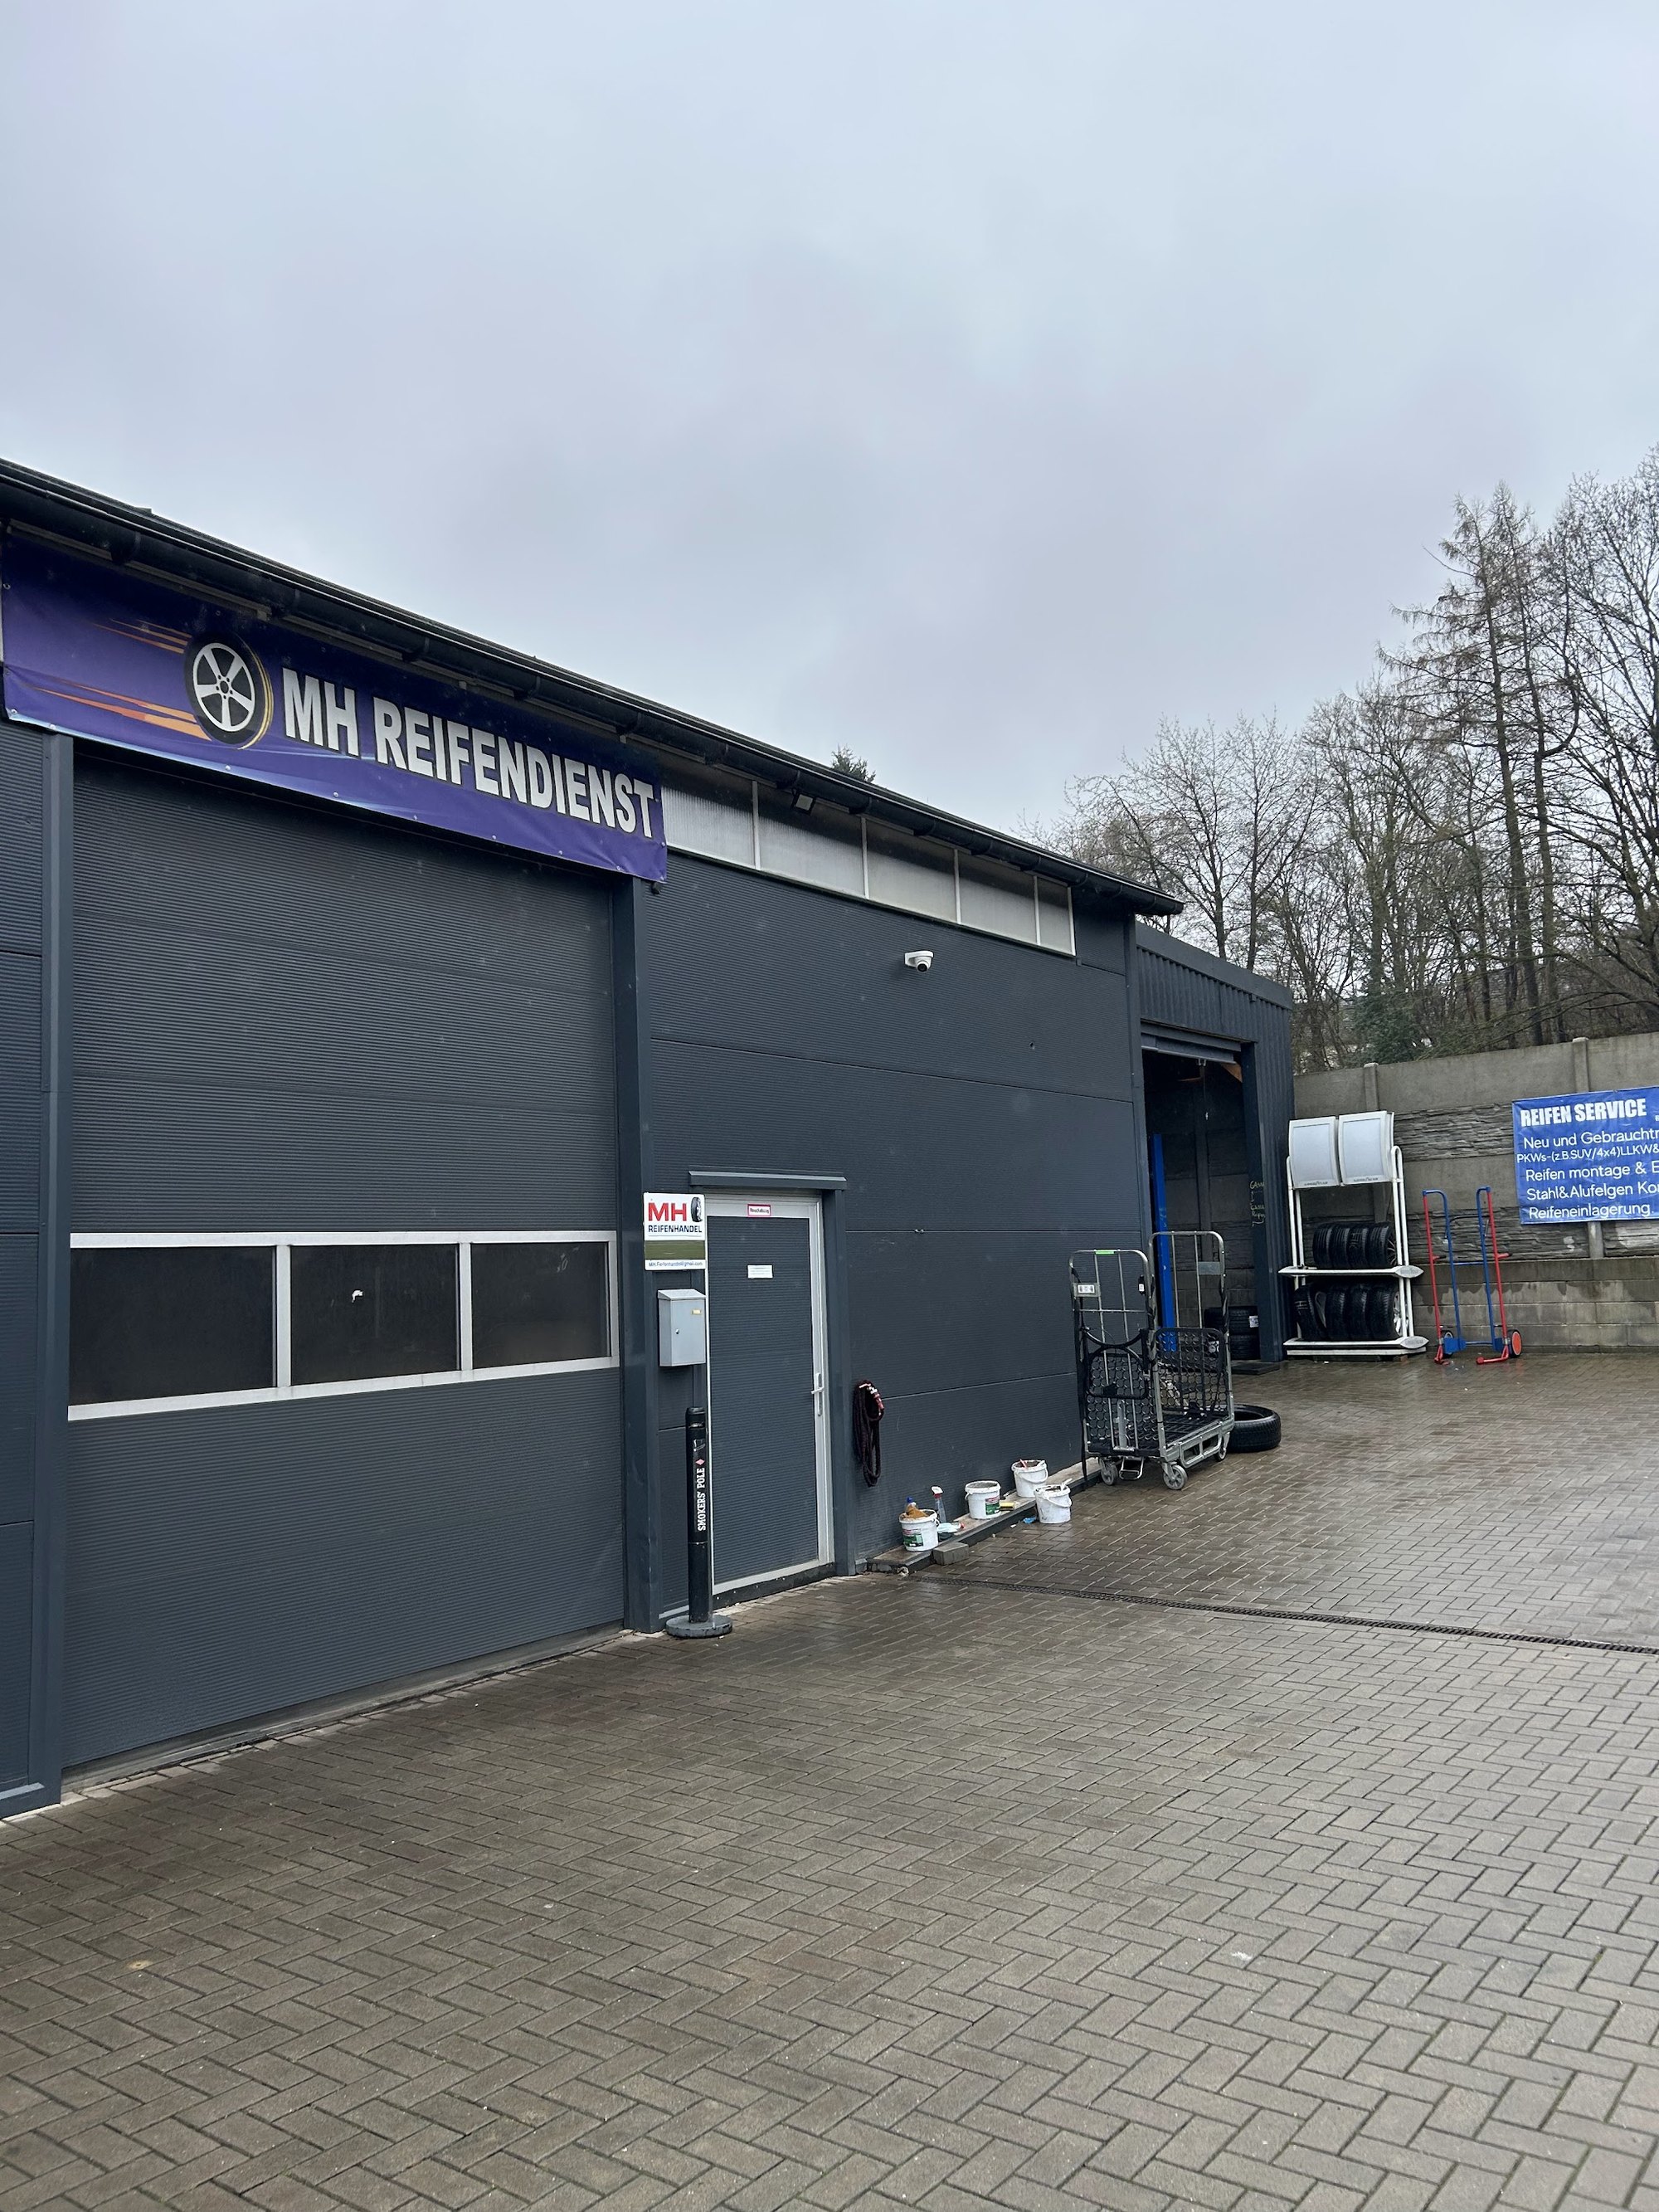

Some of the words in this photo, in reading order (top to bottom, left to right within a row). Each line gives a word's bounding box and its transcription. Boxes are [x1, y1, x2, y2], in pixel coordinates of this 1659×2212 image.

[282, 667, 359, 757] MH
[372, 696, 654, 839] REIFENDIENST
[1520, 1105, 1572, 1128] REIFEN
[1574, 1098, 1647, 1123] SERVICE
[1523, 1137, 1550, 1149] Neu
[1553, 1133, 1577, 1147] und
[1525, 1168, 1565, 1182] Reifen
[1569, 1165, 1631, 1180] montage
[1635, 1161, 1647, 1175] &
[648, 1202, 688, 1221] MH
[1529, 1203, 1655, 1220] Reifeneinlagerung.
[648, 1225, 703, 1233] REIFENHANDEL
[696, 1467, 706, 1489] POLE
